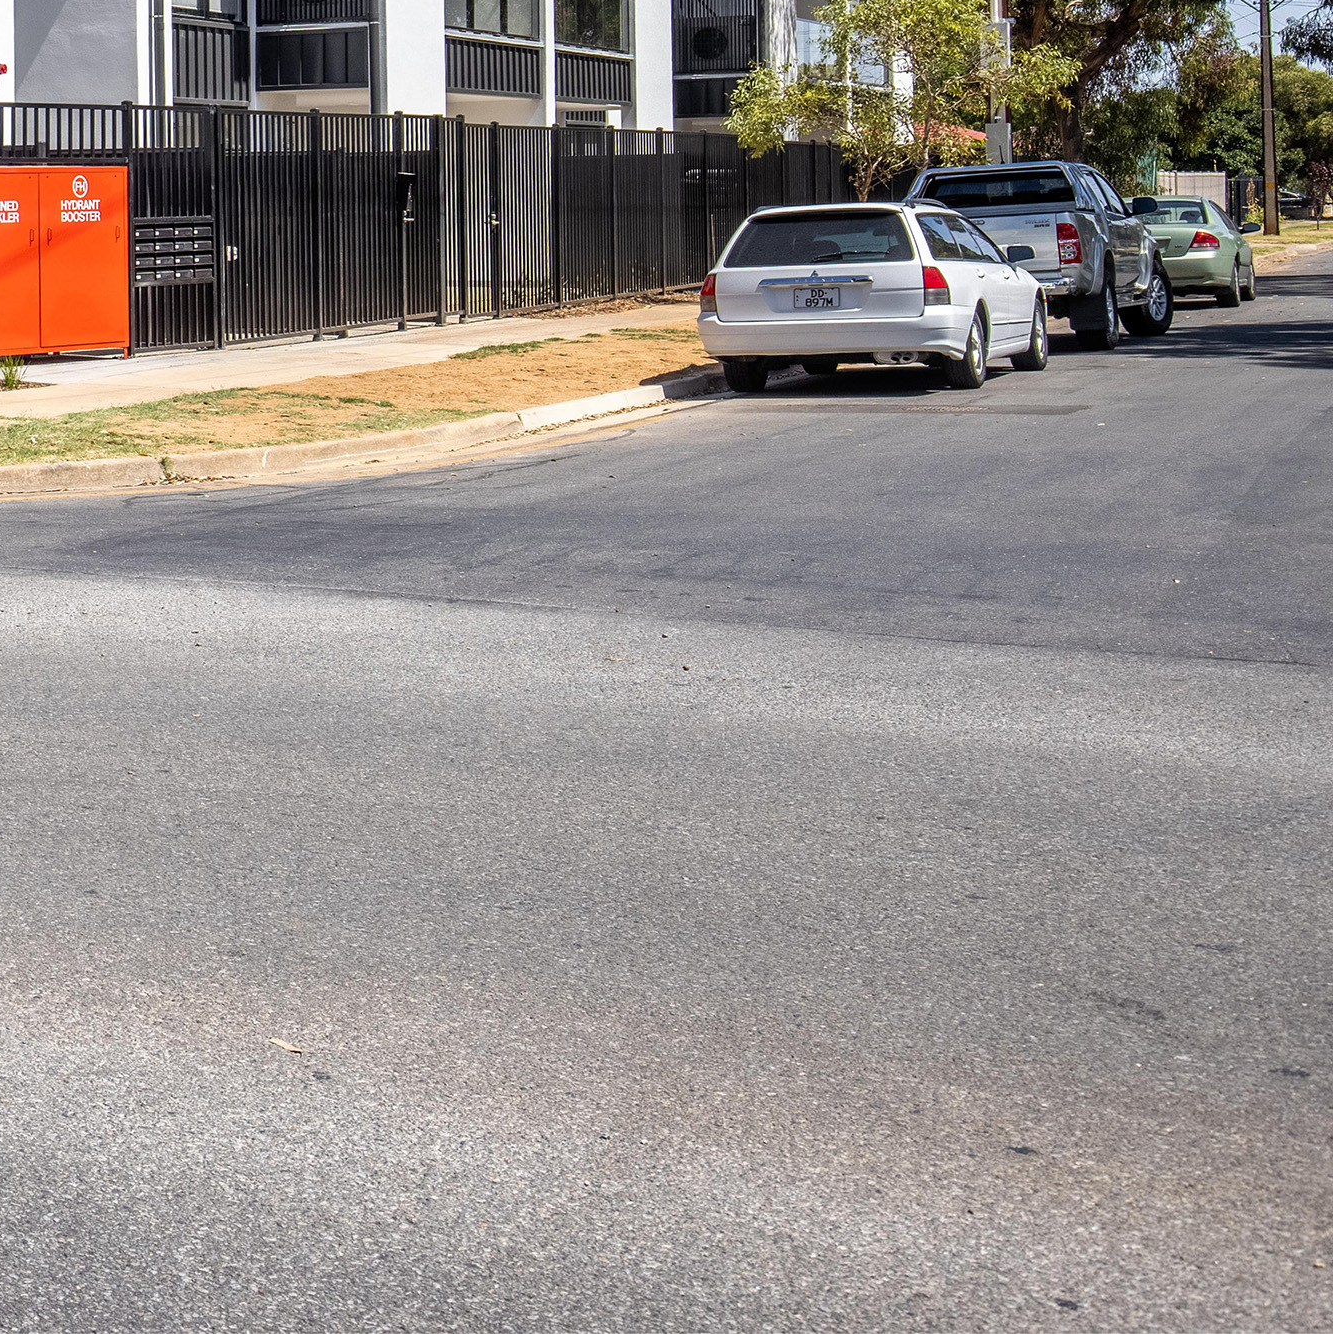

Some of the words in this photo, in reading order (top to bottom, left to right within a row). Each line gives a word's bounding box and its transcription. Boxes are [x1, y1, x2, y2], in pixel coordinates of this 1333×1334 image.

[60, 199, 101, 211] HYDRANT
[61, 211, 101, 222] BOOSTER
[805, 298, 833, 307] 897M
